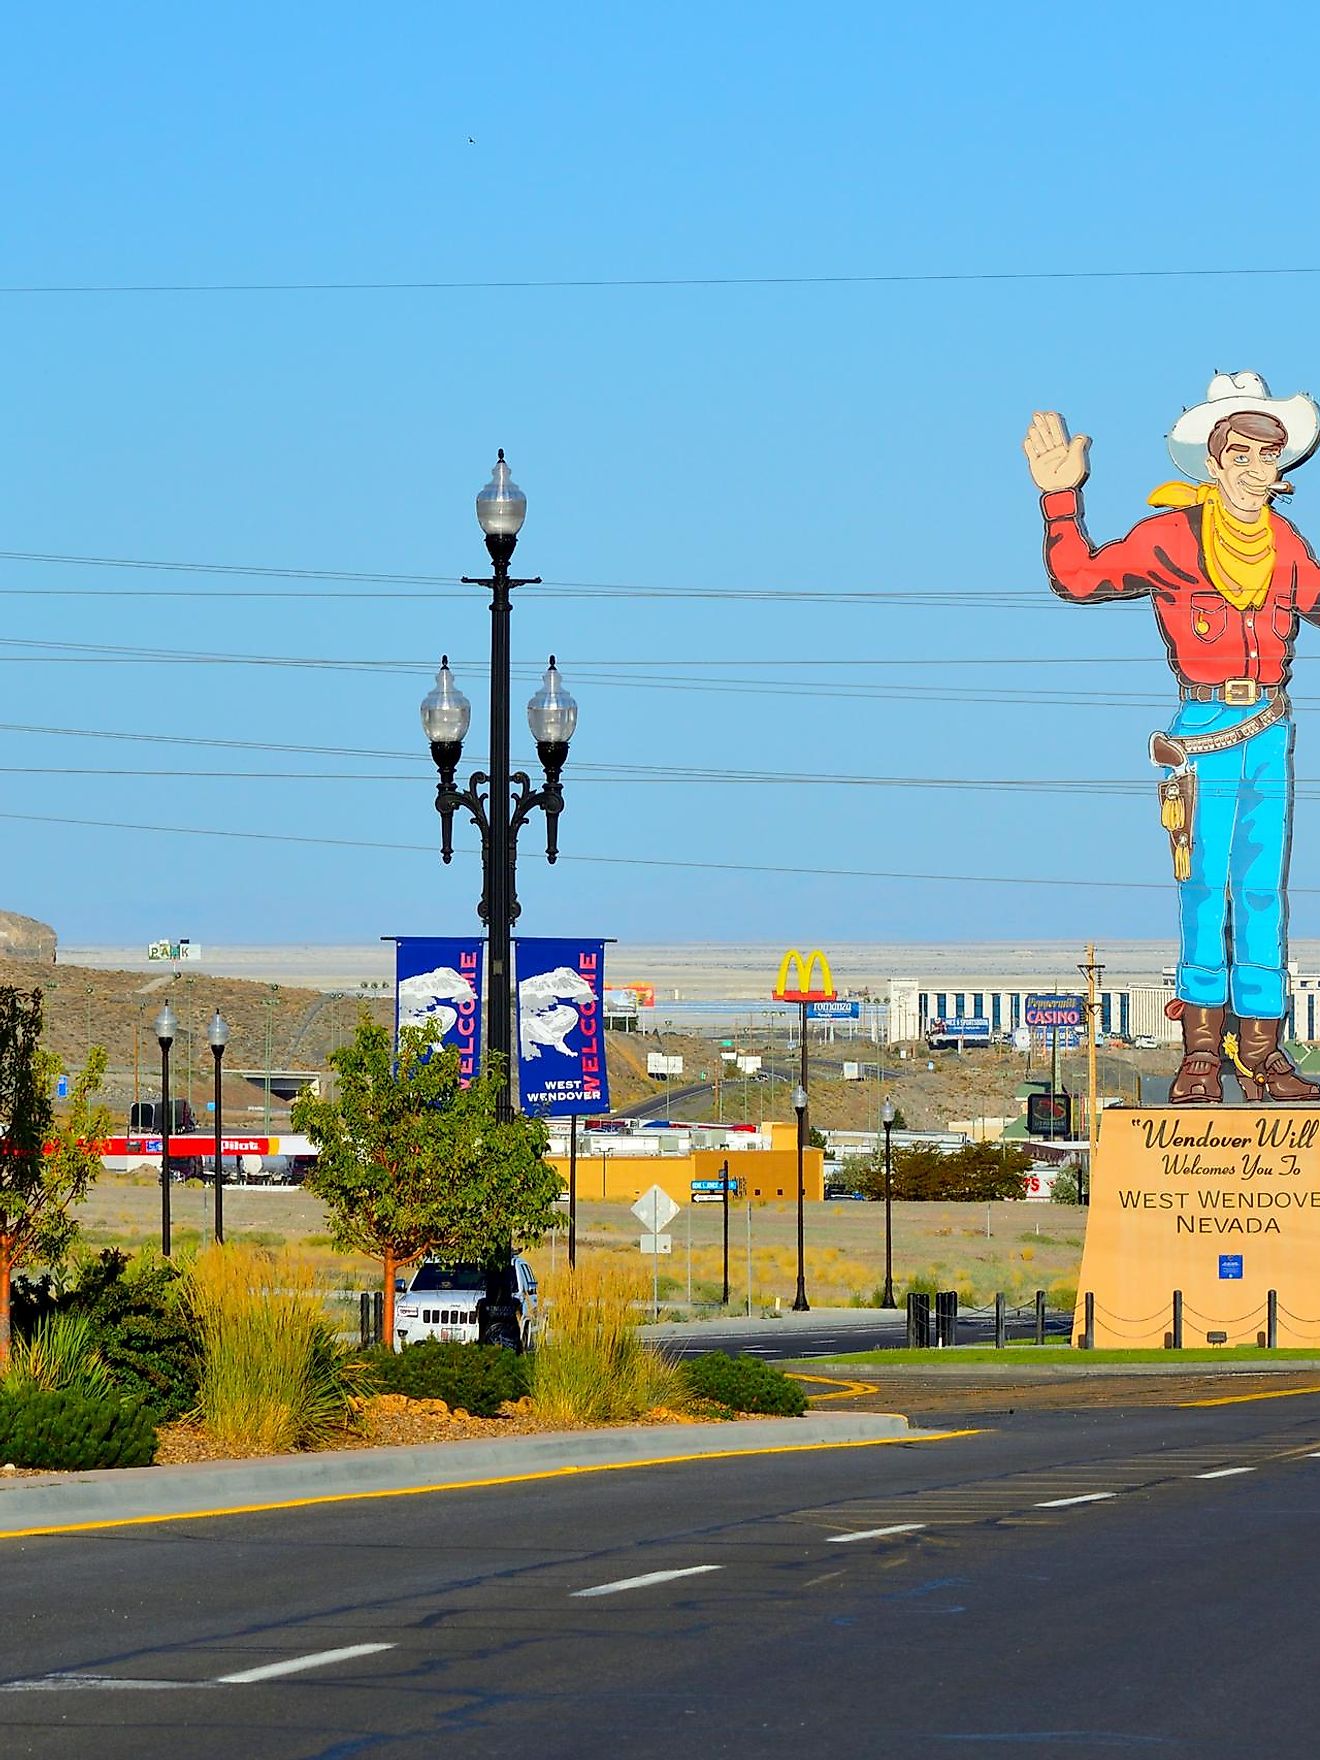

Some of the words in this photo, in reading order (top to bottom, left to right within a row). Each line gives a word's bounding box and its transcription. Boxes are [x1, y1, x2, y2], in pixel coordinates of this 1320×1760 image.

[1027, 1010, 1079, 1025] CASINO
[544, 1080, 581, 1090] WEST
[526, 1092, 601, 1103] WENDOVER
[1161, 1154, 1236, 1176] Welcomes
[1241, 1154, 1273, 1181] You
[1278, 1154, 1301, 1176] To
[1118, 1190, 1190, 1209] WEST
[1177, 1215, 1281, 1234] NEVADA
